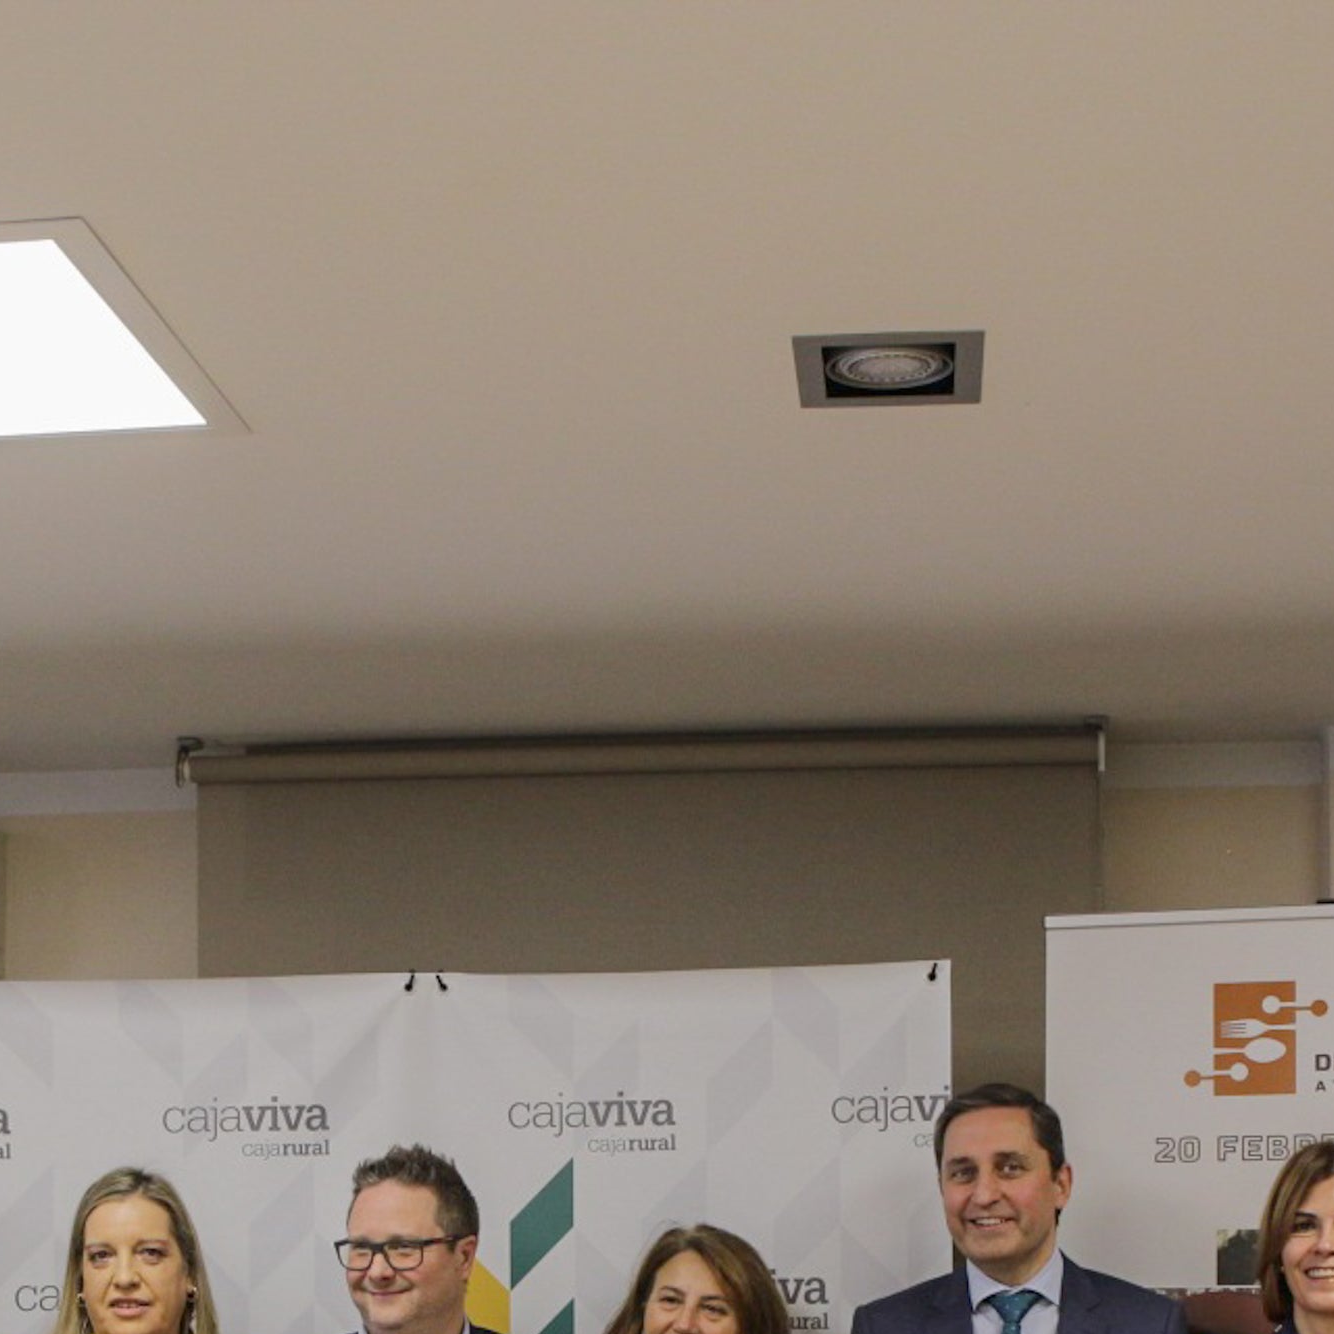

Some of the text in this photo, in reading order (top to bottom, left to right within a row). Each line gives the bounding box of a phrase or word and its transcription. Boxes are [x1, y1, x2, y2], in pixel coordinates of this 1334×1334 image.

[1315, 1079, 1327, 1092] A
[162, 1095, 331, 1143] cajaviva
[508, 1090, 676, 1138] cajaviva
[241, 1138, 331, 1161] cajarural
[587, 1132, 677, 1157] cajarural
[1154, 1135, 1202, 1164] 20
